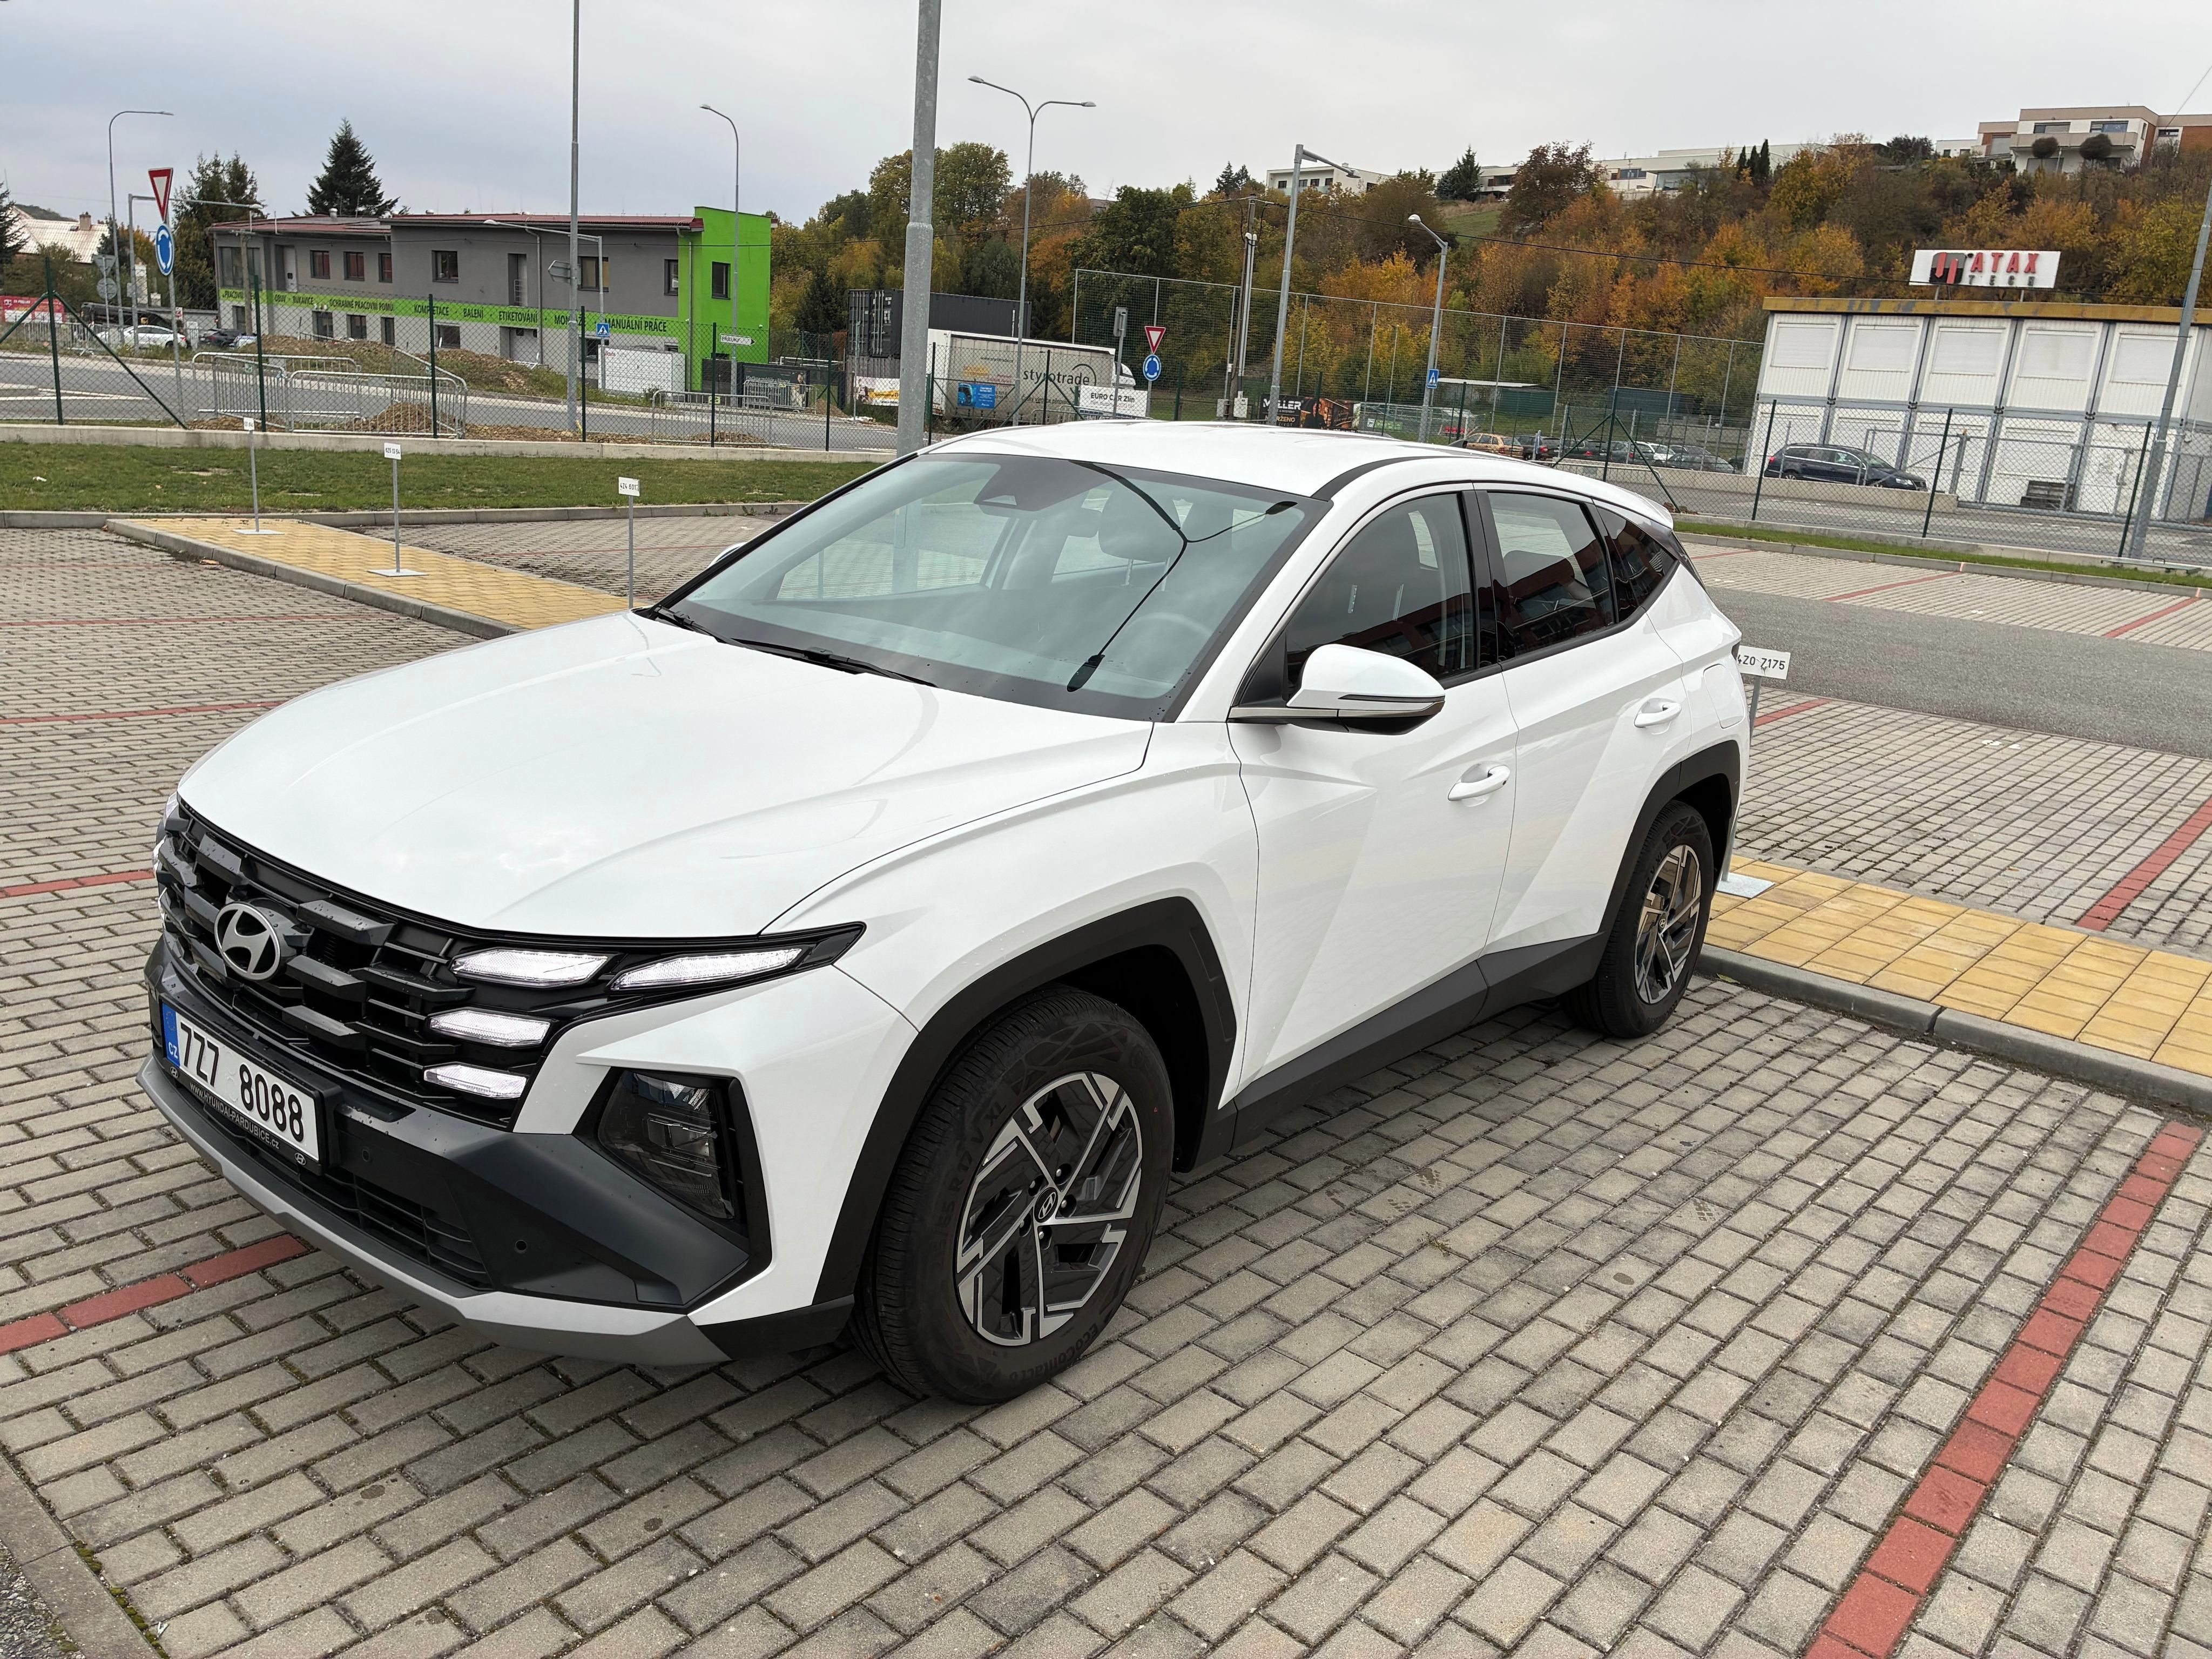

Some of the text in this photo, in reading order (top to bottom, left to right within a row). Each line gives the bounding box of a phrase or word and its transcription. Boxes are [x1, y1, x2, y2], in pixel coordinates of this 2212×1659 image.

[1970, 252, 2039, 274] ATAX
[1968, 275, 2035, 286] TECH
[414, 304, 449, 316] KOMPETACE
[463, 307, 484, 319] BALENÍ
[498, 310, 538, 323] ETIKETOVÁNÍ
[605, 317, 667, 332] MANUÁLNÍ PRÁCE
[1263, 398, 1301, 410] MLLER
[1737, 654, 1756, 666] 4Z0
[168, 1042, 178, 1059] CZ
[180, 1022, 304, 1143] 7Z7 8088
